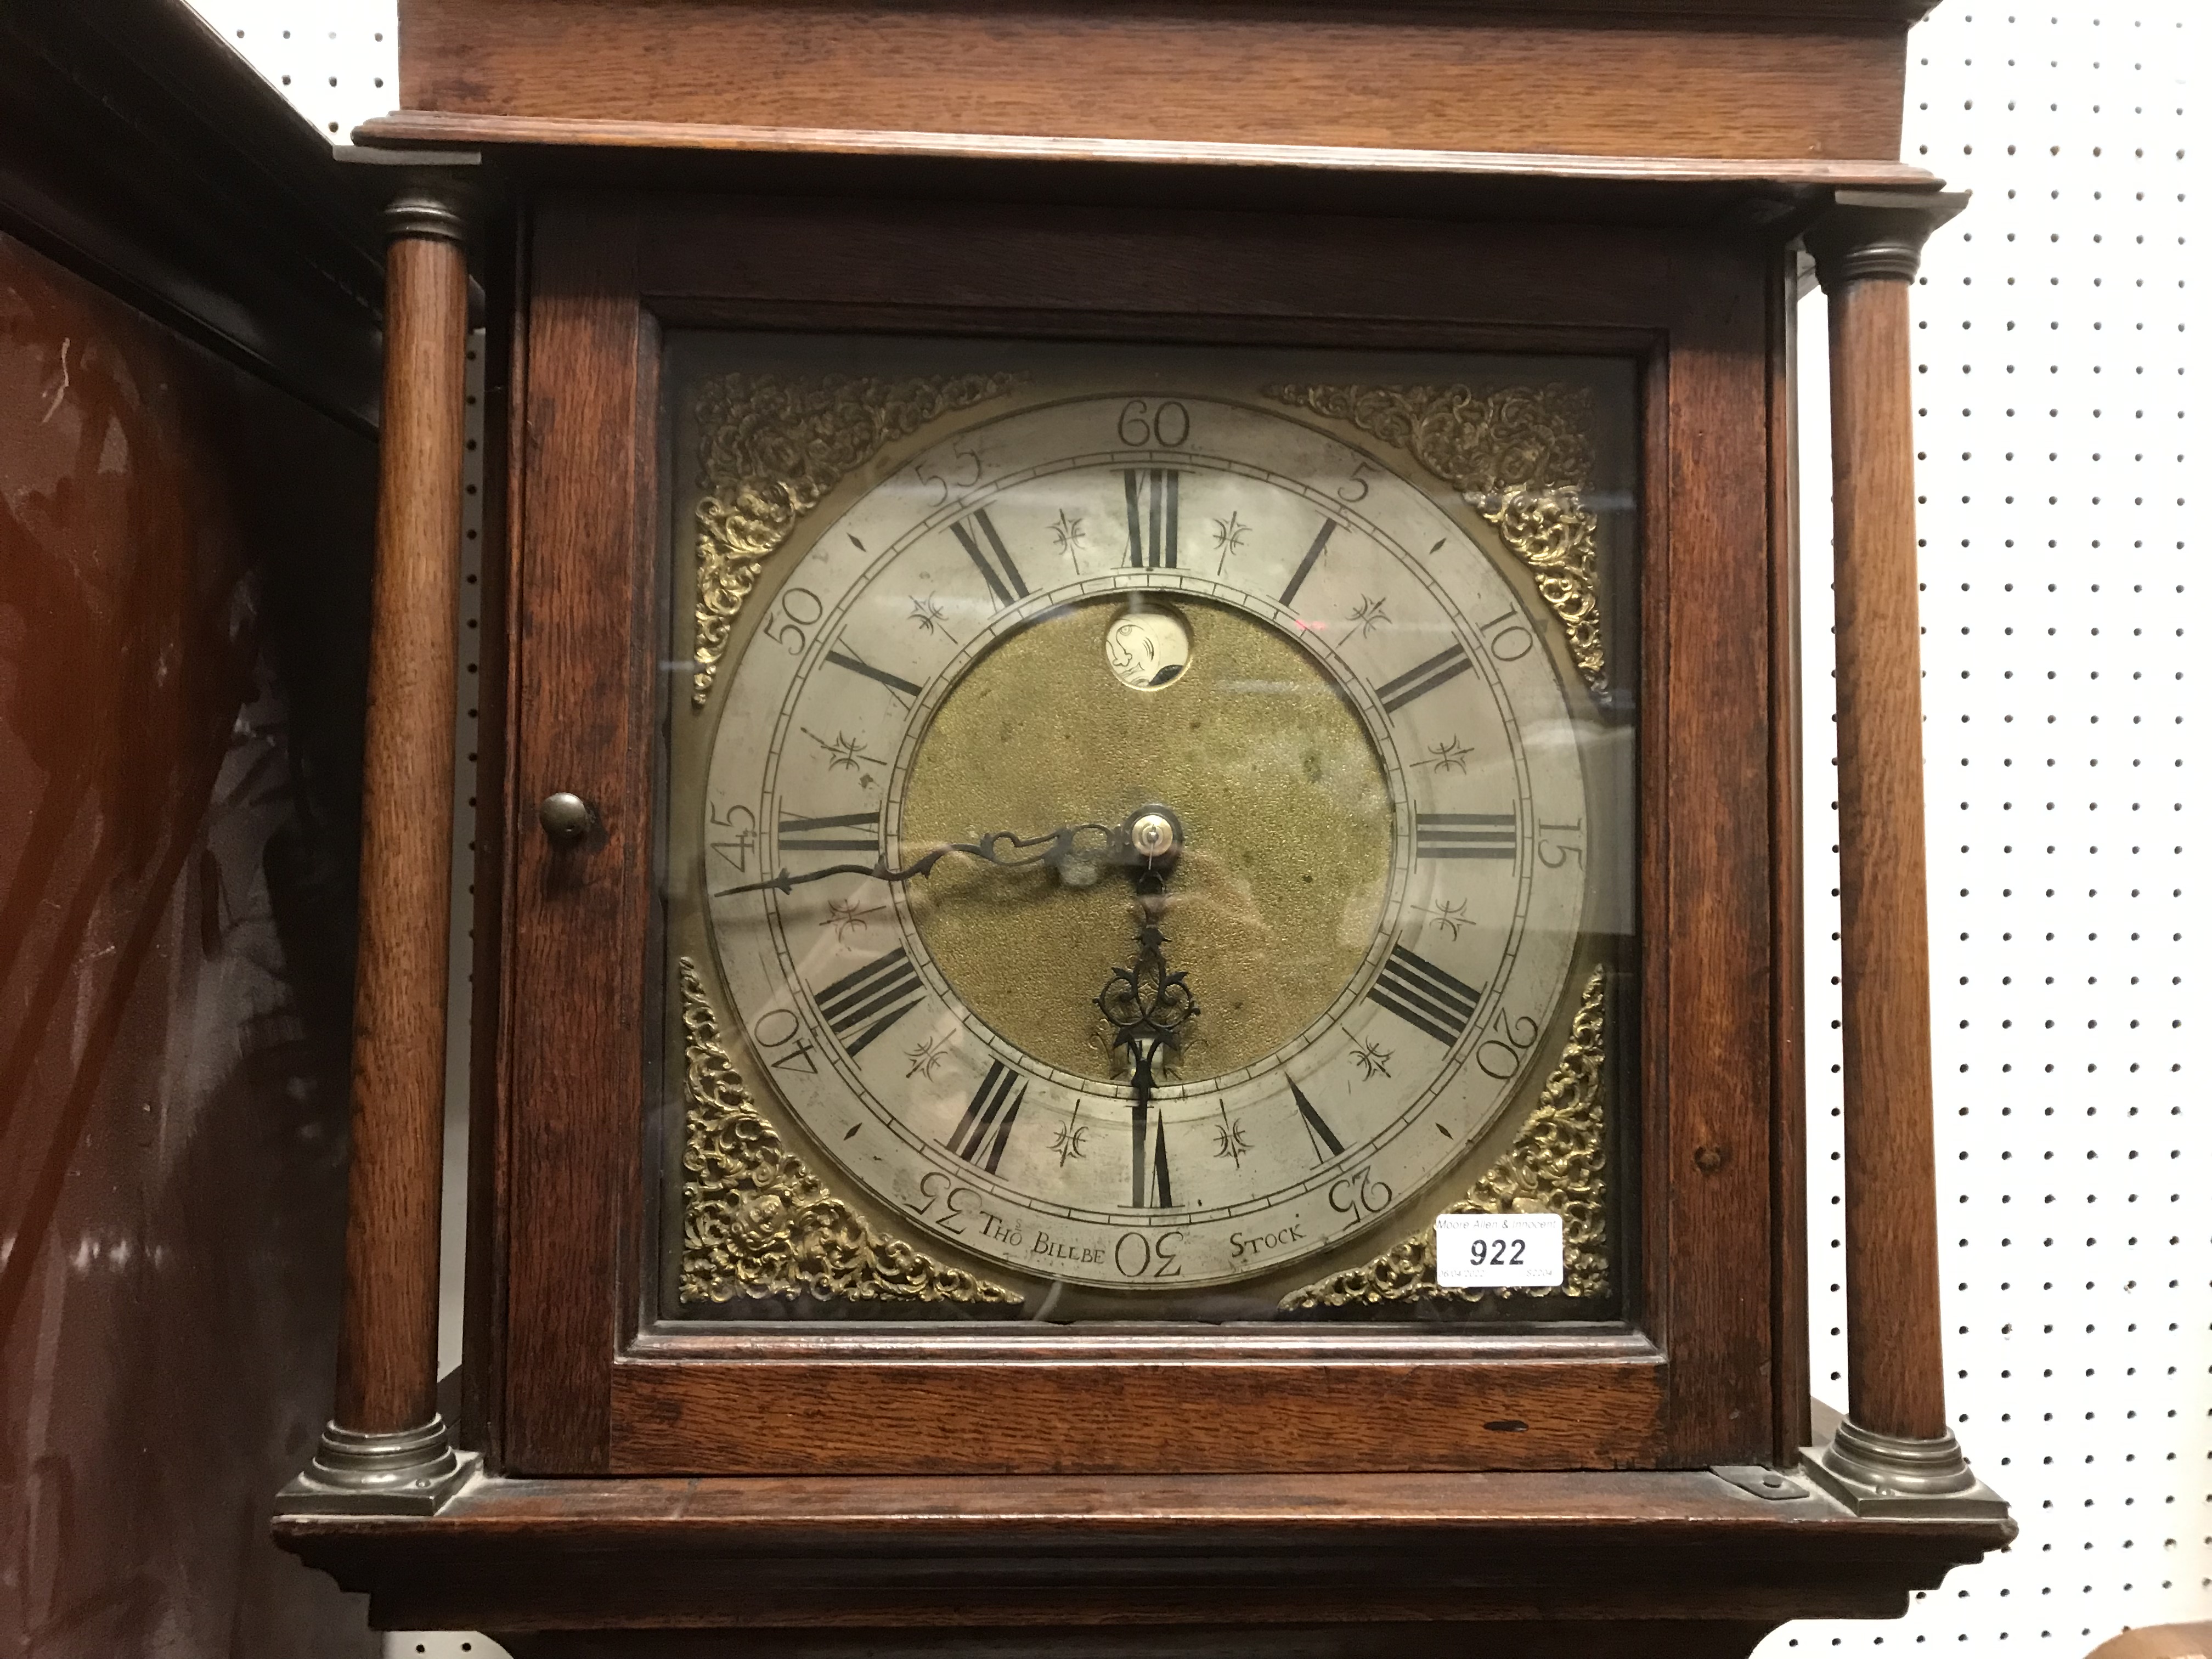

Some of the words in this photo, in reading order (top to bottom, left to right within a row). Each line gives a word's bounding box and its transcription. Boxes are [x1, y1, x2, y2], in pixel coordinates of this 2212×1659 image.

[1118, 400, 1189, 448] 60
[915, 442, 982, 508] 55
[1338, 461, 1380, 503] 5
[1110, 467, 1195, 569] XII
[939, 499, 1043, 619] XI
[1266, 509, 1352, 615] I
[764, 587, 823, 656] 50
[1476, 601, 1533, 662] 10
[819, 623, 931, 721] X
[1366, 631, 1480, 728] II
[710, 801, 756, 873] 45
[778, 795, 882, 867] IX
[1414, 799, 1516, 877] III
[1537, 817, 1584, 871] 15
[805, 938, 929, 1071] VIII
[1359, 930, 1488, 1061] IIII
[754, 1008, 818, 1075] 40
[1476, 1007, 1539, 1080] 20
[933, 1053, 1030, 1182] VII
[1284, 1071, 1357, 1170] V
[1118, 1105, 1185, 1208] VI
[901, 1172, 983, 1235] 35
[1328, 1165, 1392, 1231] 25
[1437, 1220, 1469, 1229] Moore
[1472, 1220, 1498, 1229] Allen
[1502, 1220, 1509, 1229] &
[1115, 1231, 1184, 1278] 30
[1470, 1239, 1526, 1266] 922
